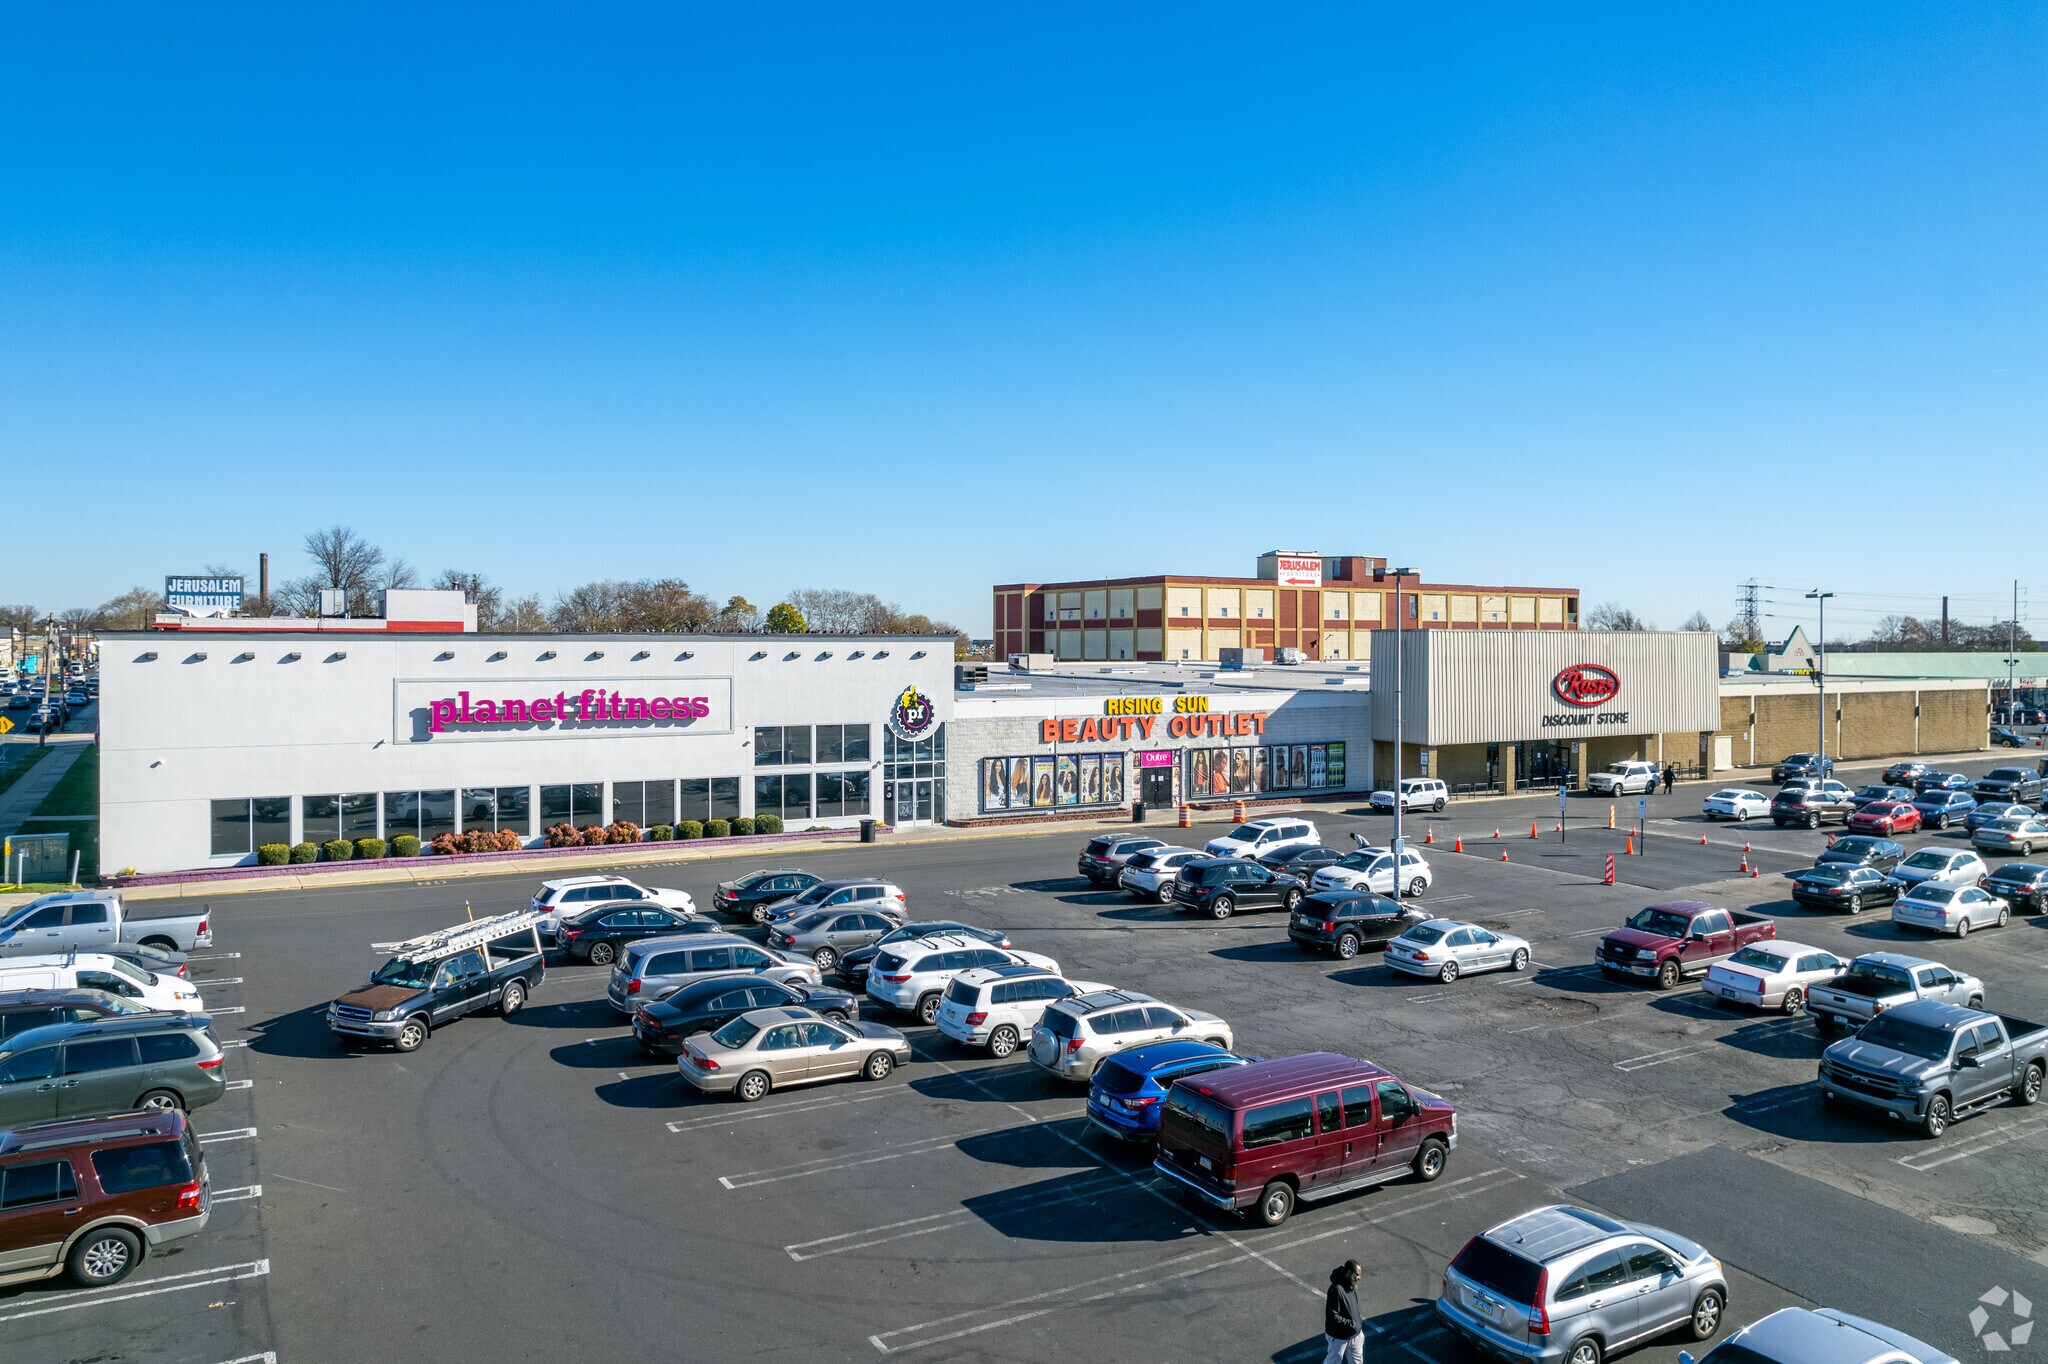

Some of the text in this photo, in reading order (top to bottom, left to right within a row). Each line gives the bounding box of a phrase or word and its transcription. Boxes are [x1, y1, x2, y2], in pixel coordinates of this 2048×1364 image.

[1280, 560, 1320, 571] JERUSALEM
[168, 578, 241, 593] JERUSALEM
[429, 688, 710, 733] planet fitness
[906, 704, 925, 723] pf
[1107, 695, 1209, 715] RISING SUN
[1043, 712, 1269, 743] BEAUTY OUTLET
[1542, 711, 1629, 728] DISCOUNT STORE
[596, 861, 688, 872] PARKING
